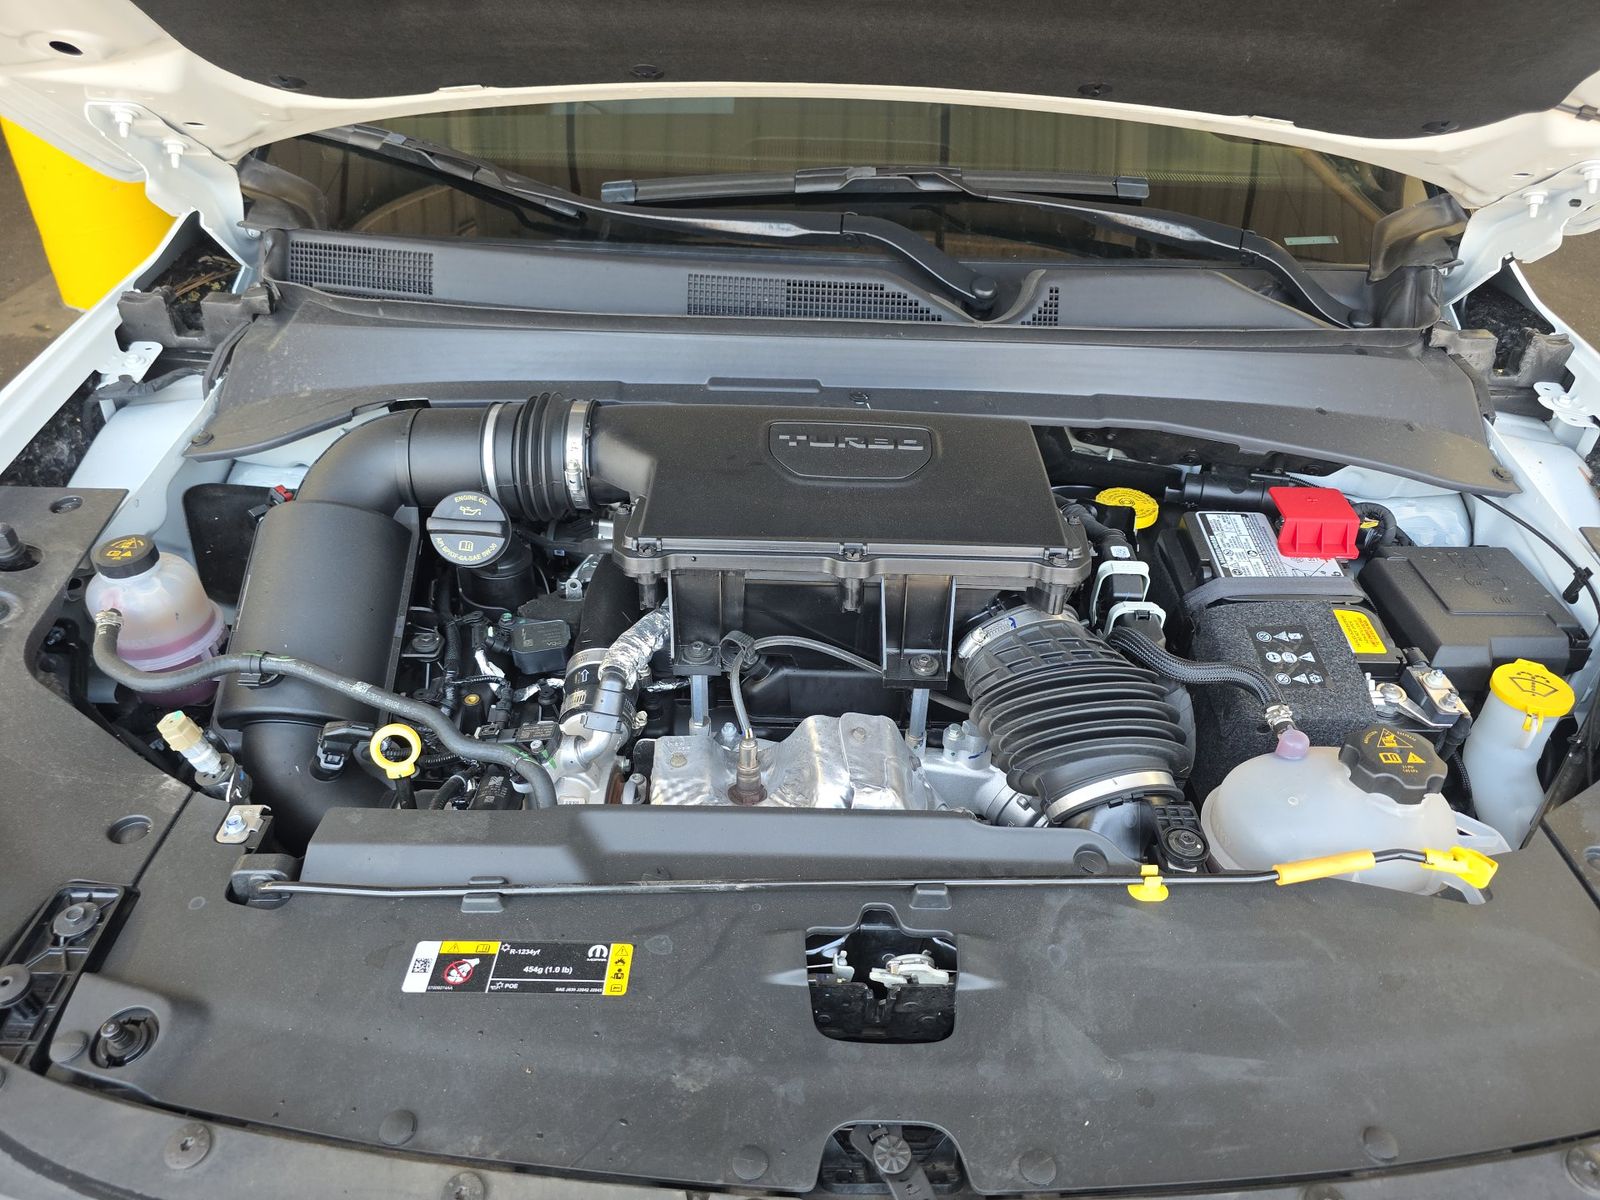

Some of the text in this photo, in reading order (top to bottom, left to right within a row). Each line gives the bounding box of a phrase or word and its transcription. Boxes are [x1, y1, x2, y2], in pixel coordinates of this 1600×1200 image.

[779, 434, 923, 451] TURBO
[454, 495, 488, 506] ENGINE OIL
[509, 948, 541, 956] R-1234yf
[523, 965, 573, 975] 454g (1.0 lb)
